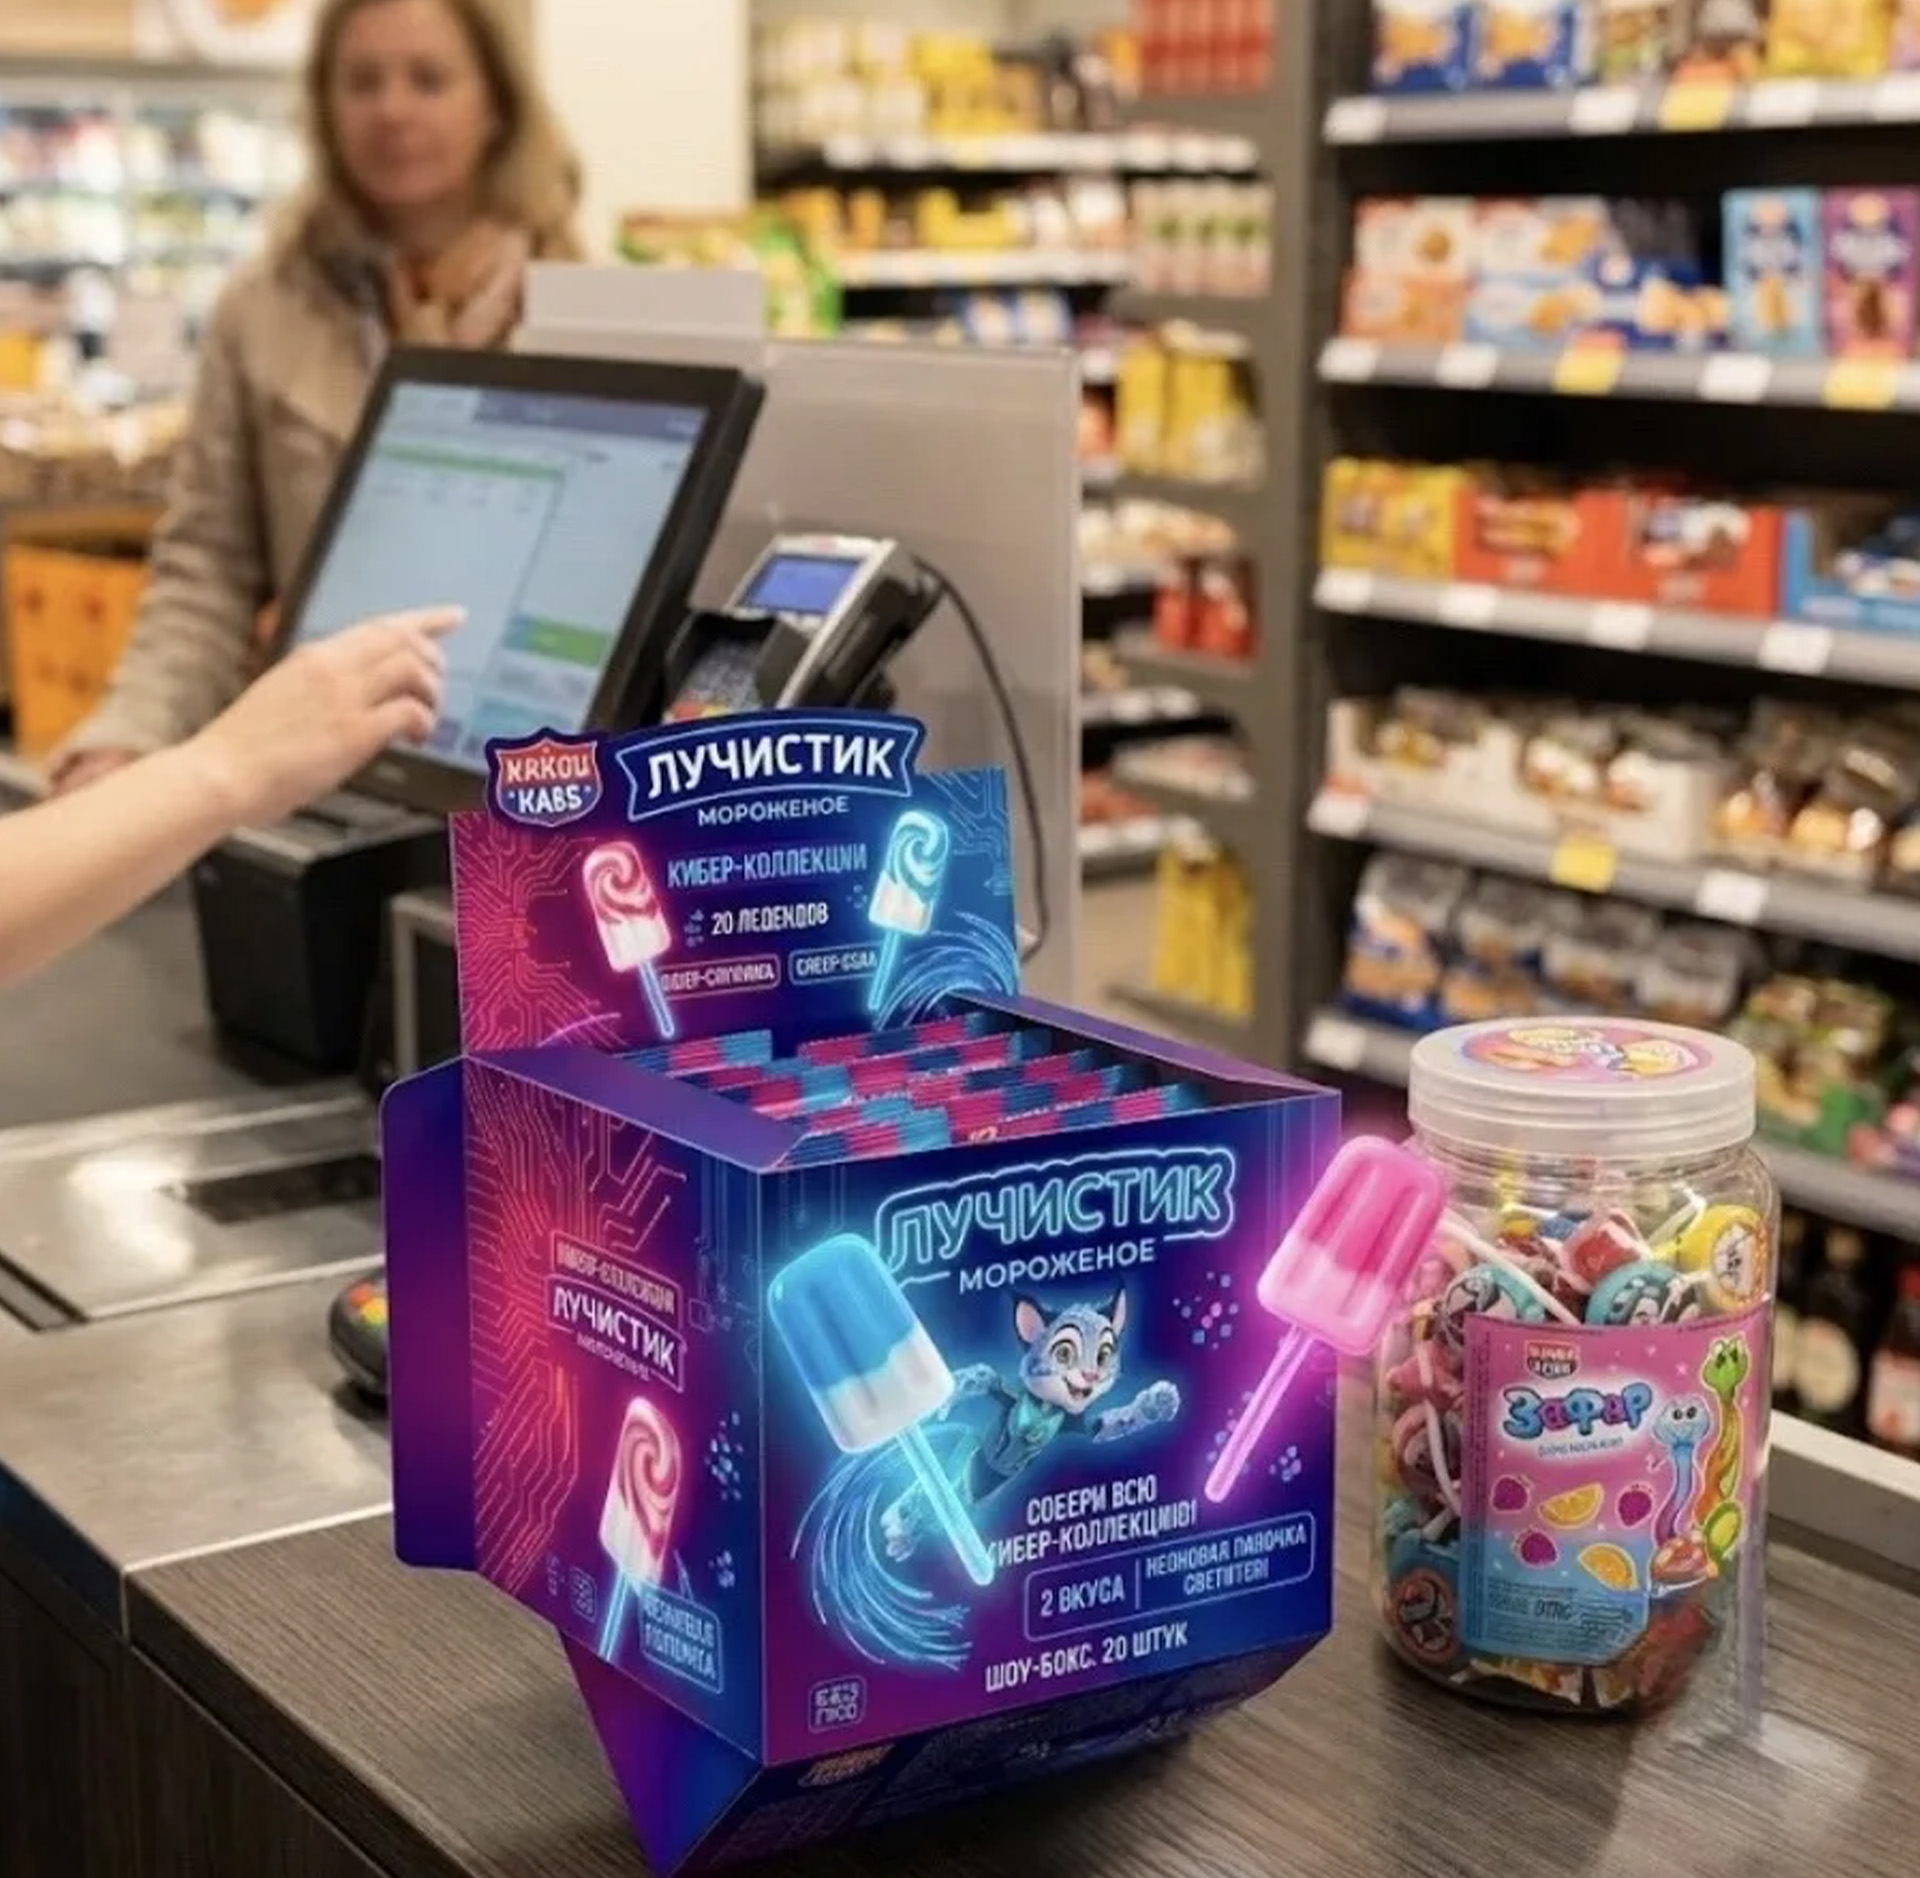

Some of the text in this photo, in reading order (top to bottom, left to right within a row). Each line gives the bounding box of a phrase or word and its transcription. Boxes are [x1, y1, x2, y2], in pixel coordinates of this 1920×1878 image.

[648, 733, 896, 799] ЛУЧИСТИК
[697, 796, 849, 827] МОРОЖЕНОЕ
[711, 911, 734, 936] 20
[887, 1164, 1223, 1274] ЛУЧИСТИК
[959, 1238, 1156, 1294] МОРОЖЕНОЕ
[1112, 1474, 1158, 1509] ВСЮ
[1040, 1574, 1125, 1617] 2 ВКУСА
[1102, 1635, 1127, 1664] 20
[1132, 1621, 1188, 1657] ШТУК
